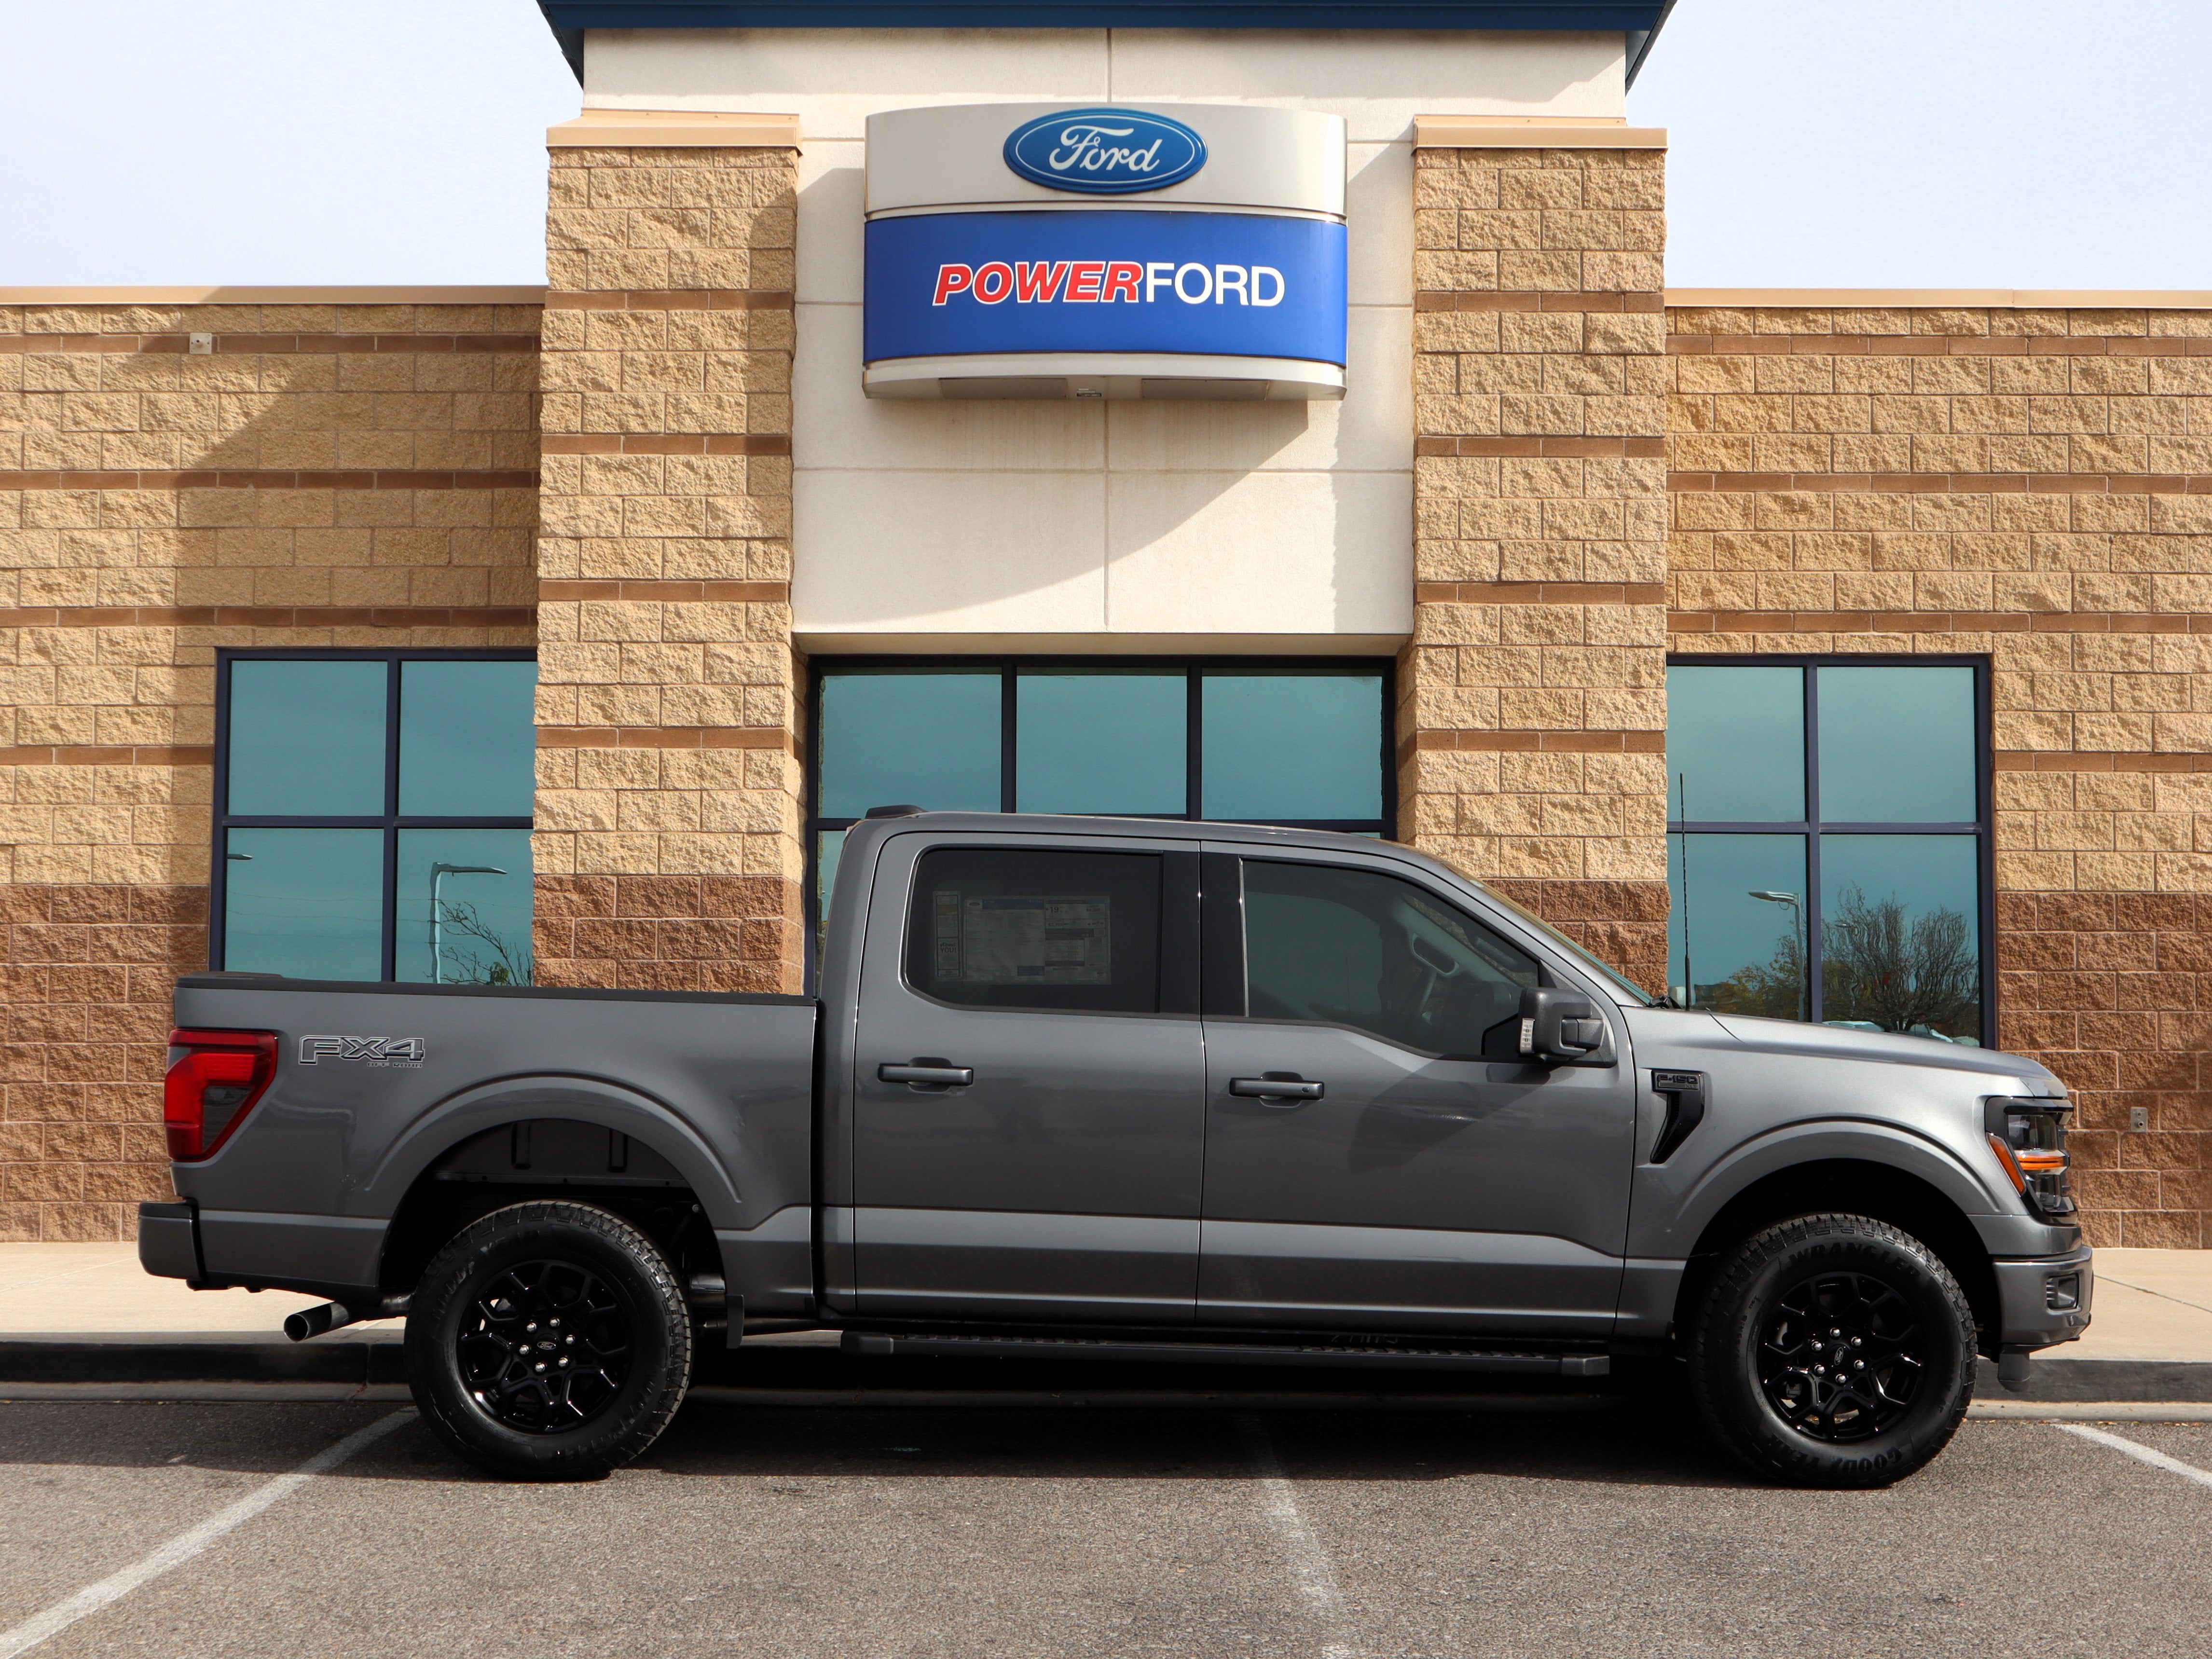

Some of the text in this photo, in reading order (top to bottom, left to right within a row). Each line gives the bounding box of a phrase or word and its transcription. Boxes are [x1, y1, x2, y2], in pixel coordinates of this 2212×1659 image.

[1048, 125, 1163, 173] Ford
[932, 261, 1285, 307] POWERFORD
[298, 1035, 426, 1066] FX4
[1657, 1074, 1698, 1084] F-150
[1787, 1241, 1922, 1278] WRANGLER
